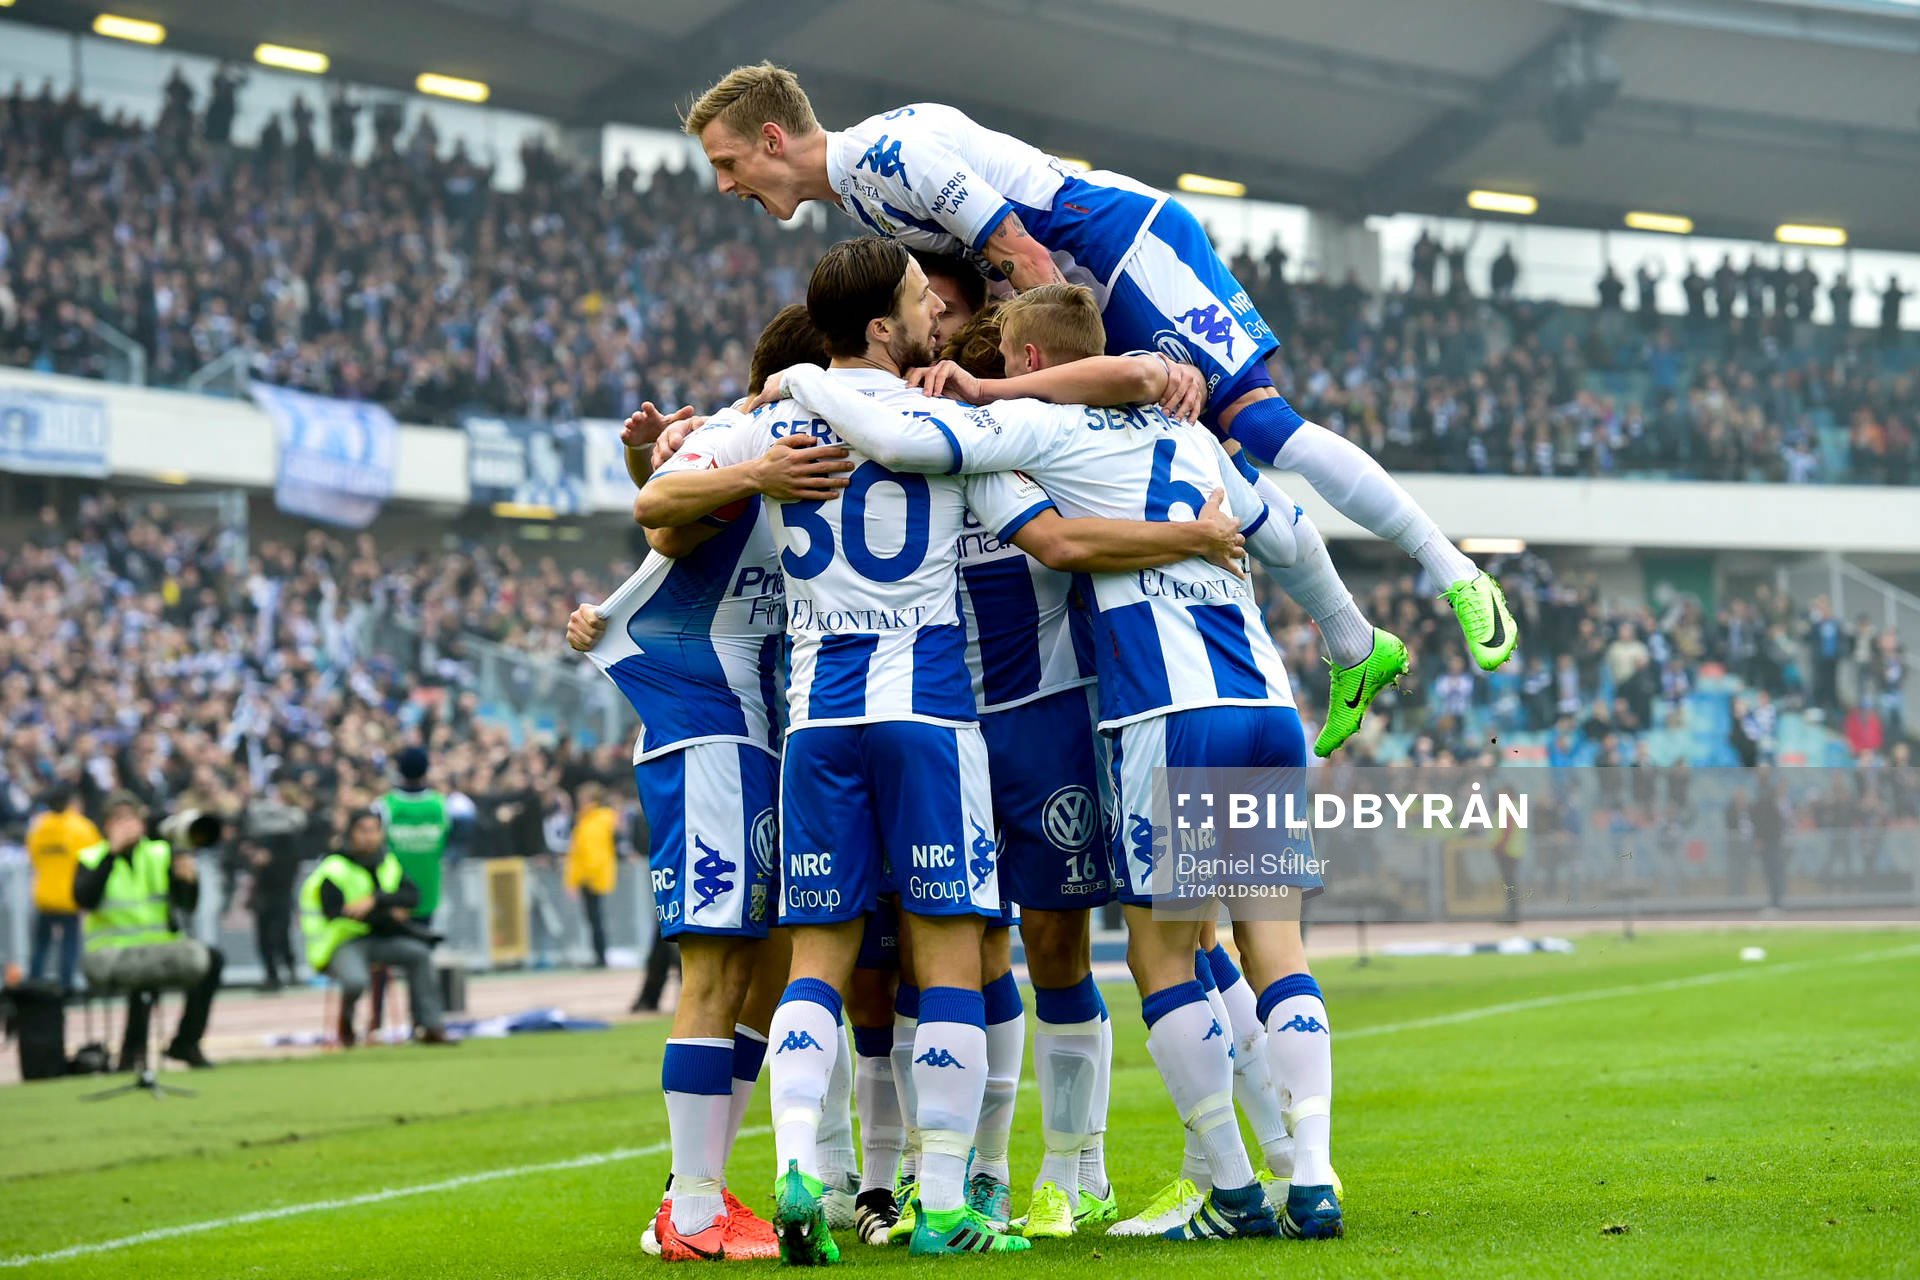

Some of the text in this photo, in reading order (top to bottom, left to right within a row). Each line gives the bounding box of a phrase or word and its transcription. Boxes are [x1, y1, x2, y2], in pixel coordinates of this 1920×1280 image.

[931, 171, 967, 214] MORRIS
[946, 187, 969, 215] LAW
[1144, 438, 1206, 522] 6
[780, 459, 931, 582] 30
[790, 852, 832, 877] NRC
[911, 844, 956, 868] NRC
[1066, 853, 1097, 883] 16
[650, 867, 677, 893] RC
[909, 875, 967, 904] Group
[1061, 879, 1107, 895] Kappa
[788, 885, 842, 912] Group
